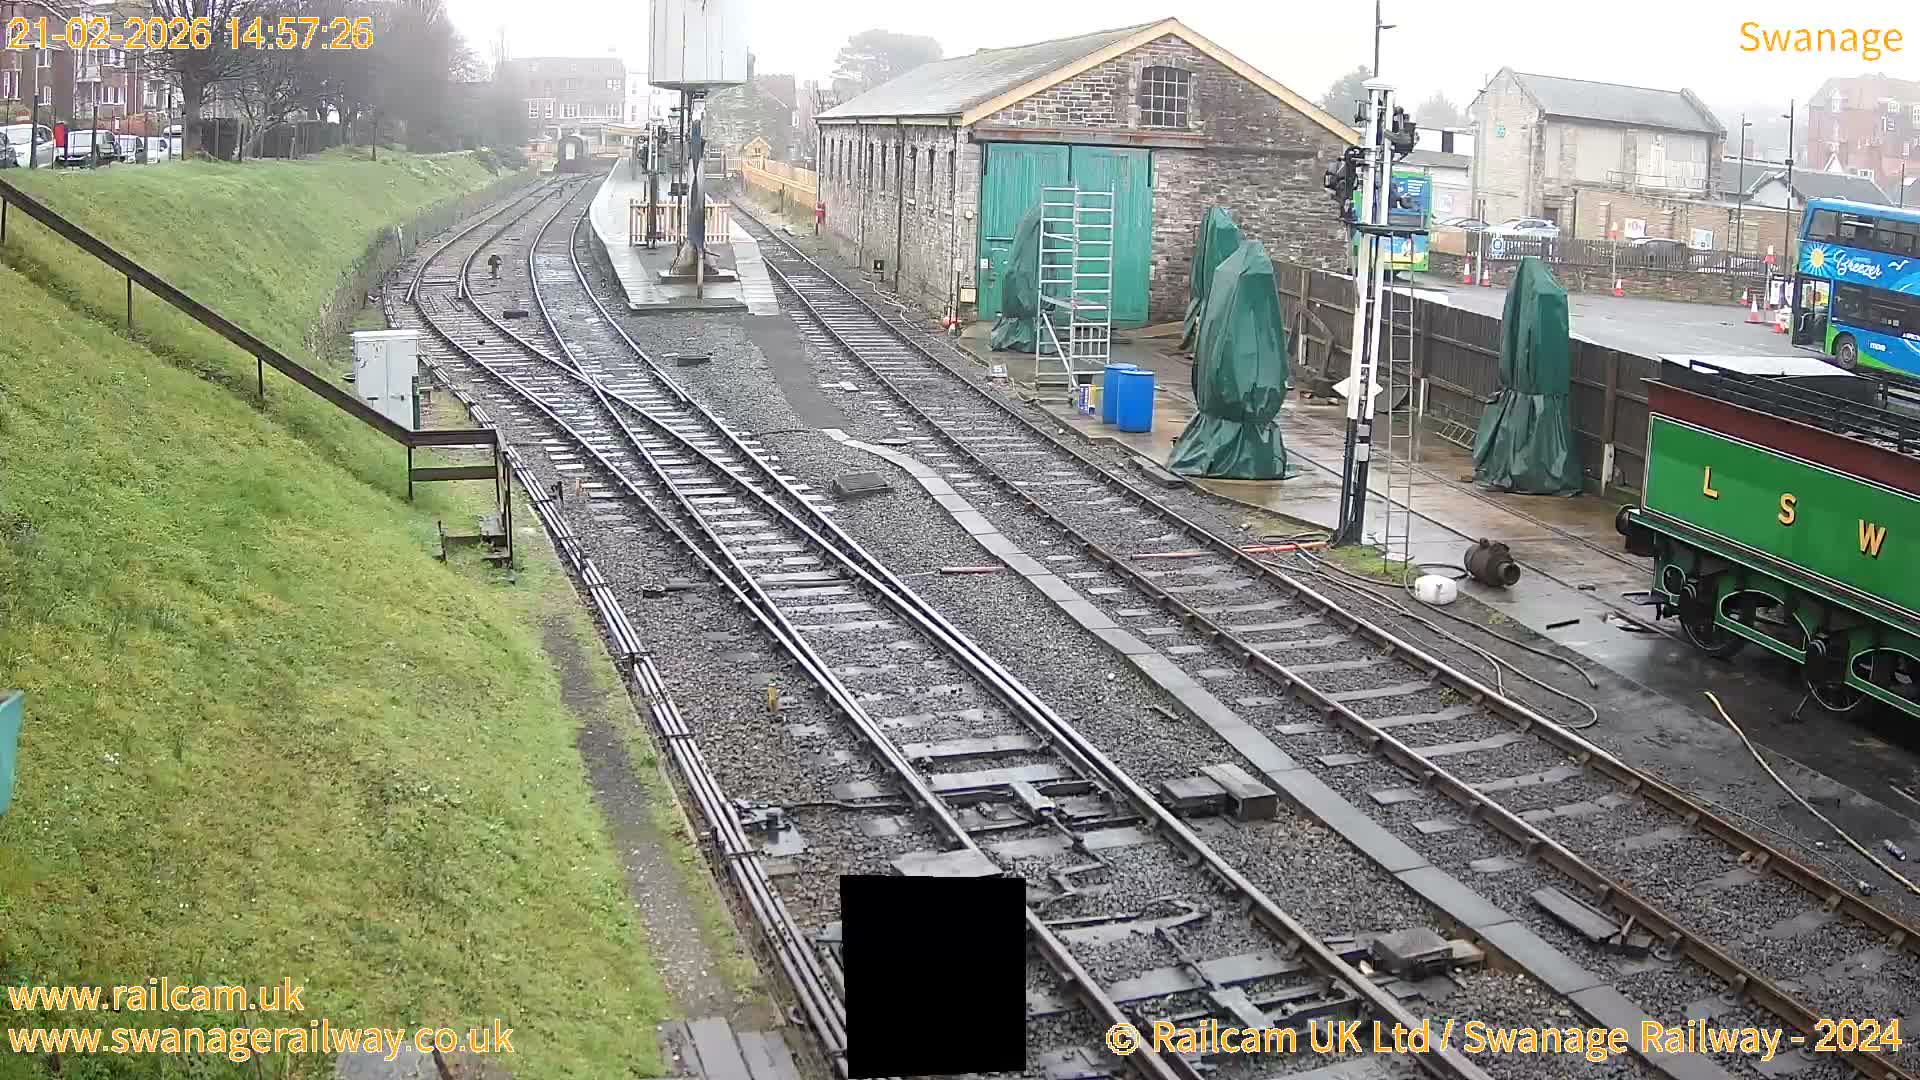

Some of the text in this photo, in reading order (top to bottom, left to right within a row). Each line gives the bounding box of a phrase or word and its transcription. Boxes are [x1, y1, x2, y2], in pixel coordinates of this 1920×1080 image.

[1834, 250, 1882, 279] Breezer
[1703, 465, 1887, 559] L S W
